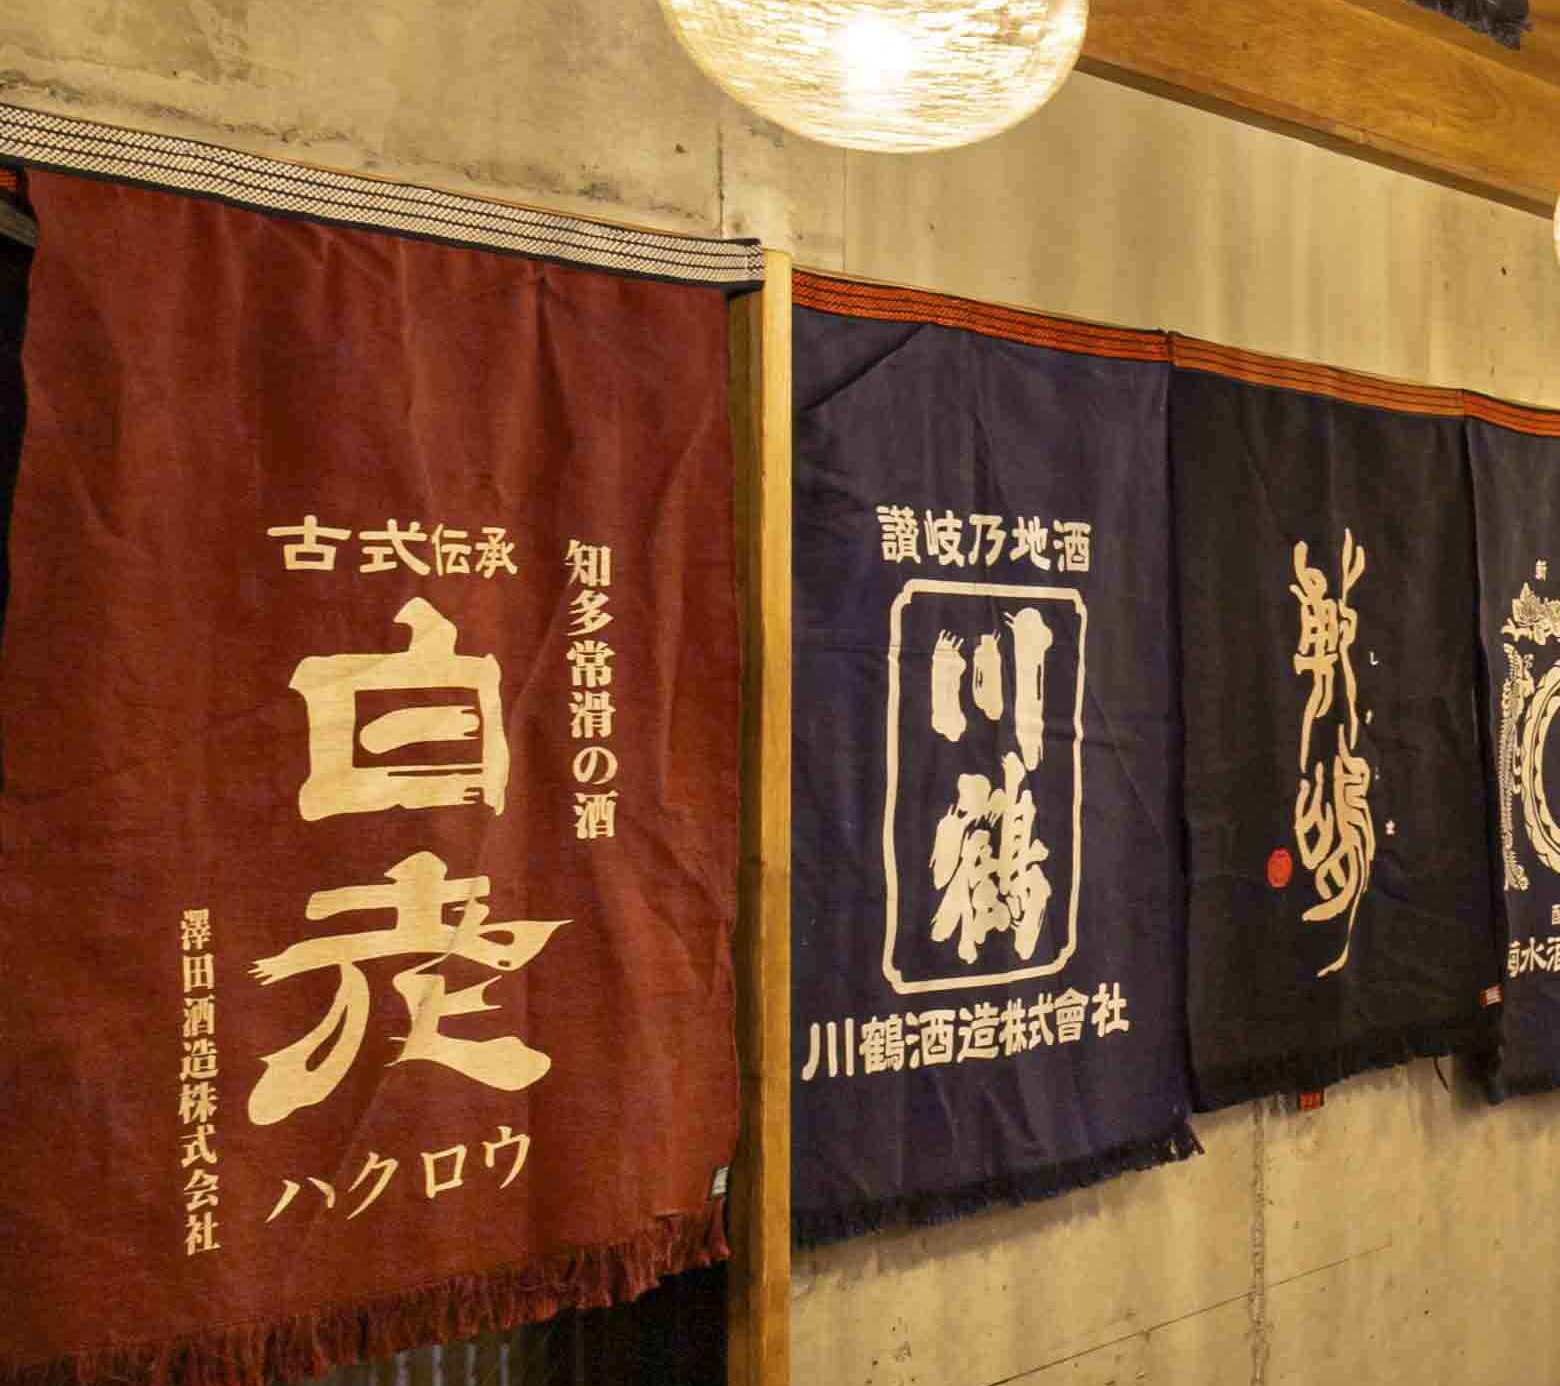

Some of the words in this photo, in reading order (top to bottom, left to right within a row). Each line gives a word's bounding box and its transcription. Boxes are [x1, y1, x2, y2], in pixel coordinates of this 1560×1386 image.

[267, 514, 518, 577] 古式伝承
[565, 539, 618, 841] 知多常滑の酒
[247, 597, 574, 1126] 白老
[931, 607, 1053, 964] 川鶴
[179, 907, 221, 1257] 澤田酒造株式会社
[264, 1126, 532, 1224] ハクロウ
